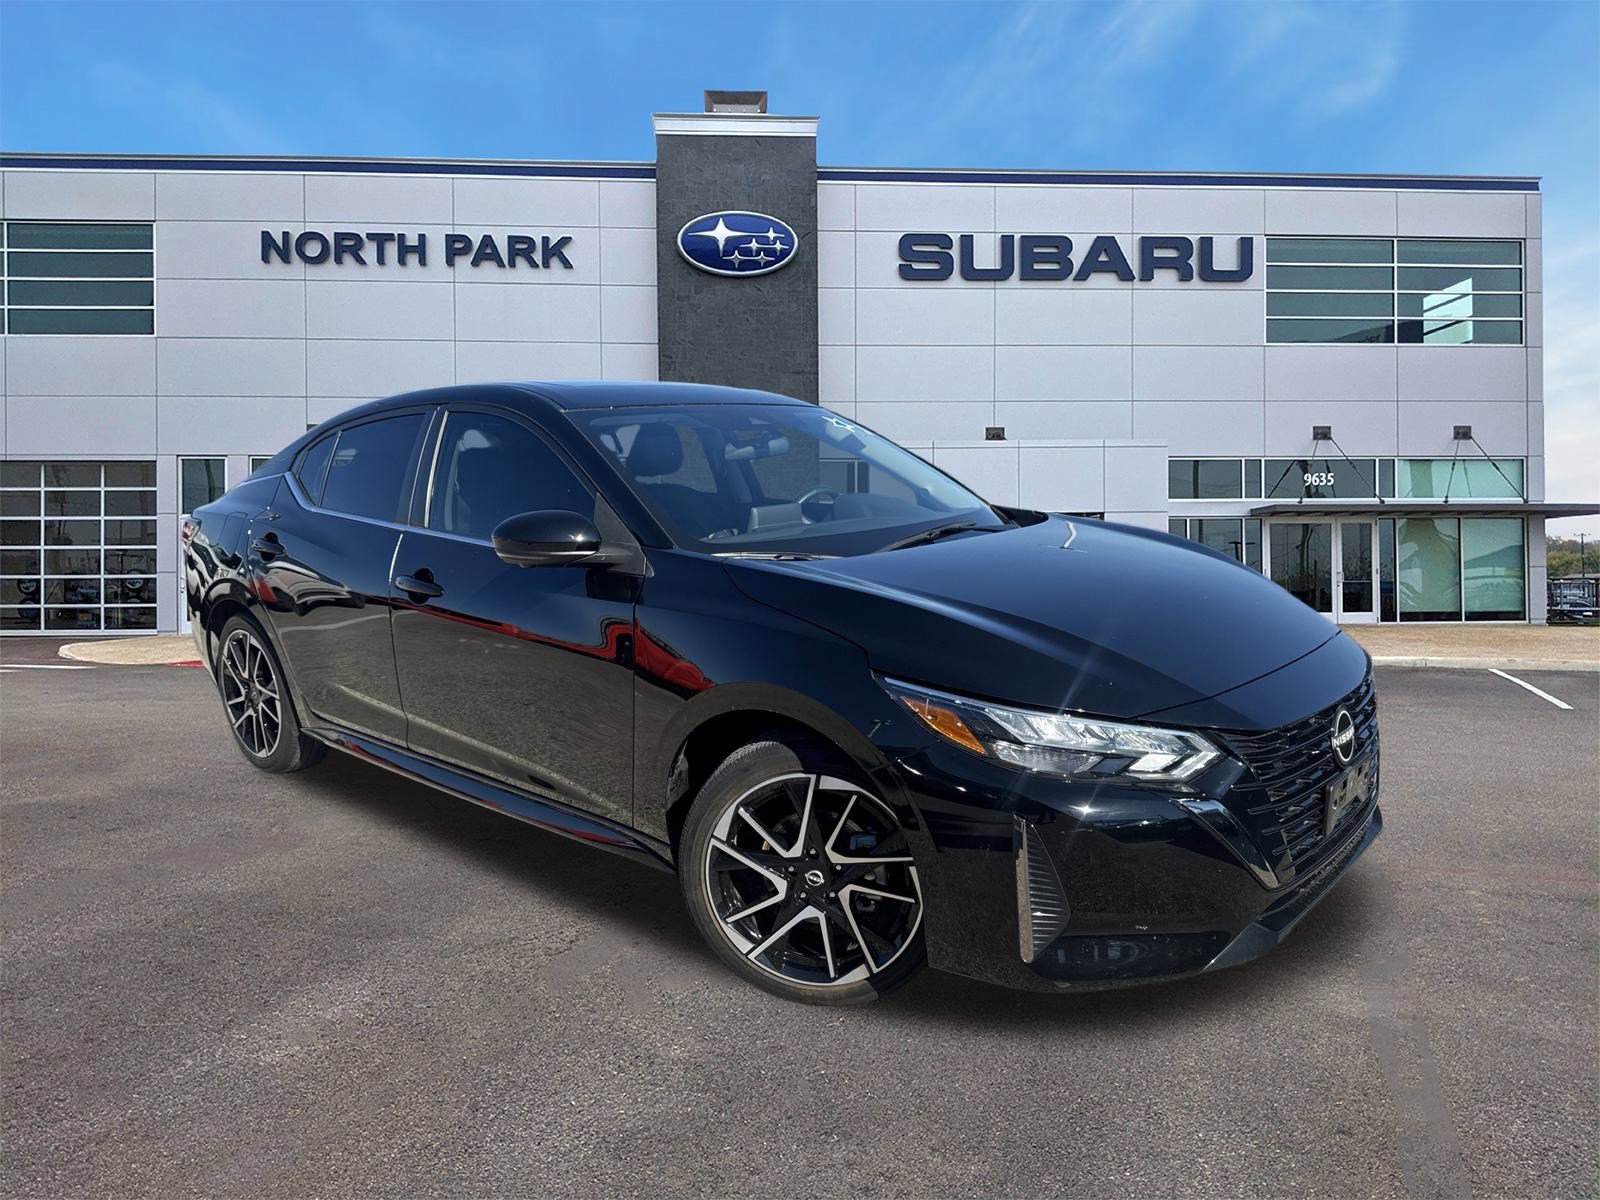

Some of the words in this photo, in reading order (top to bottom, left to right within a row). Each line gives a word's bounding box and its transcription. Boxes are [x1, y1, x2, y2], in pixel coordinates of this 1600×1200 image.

[260, 230, 427, 267] NORTH
[444, 233, 574, 270] PARK
[898, 233, 1254, 282] SUBARU
[1303, 472, 1335, 486] 9635
